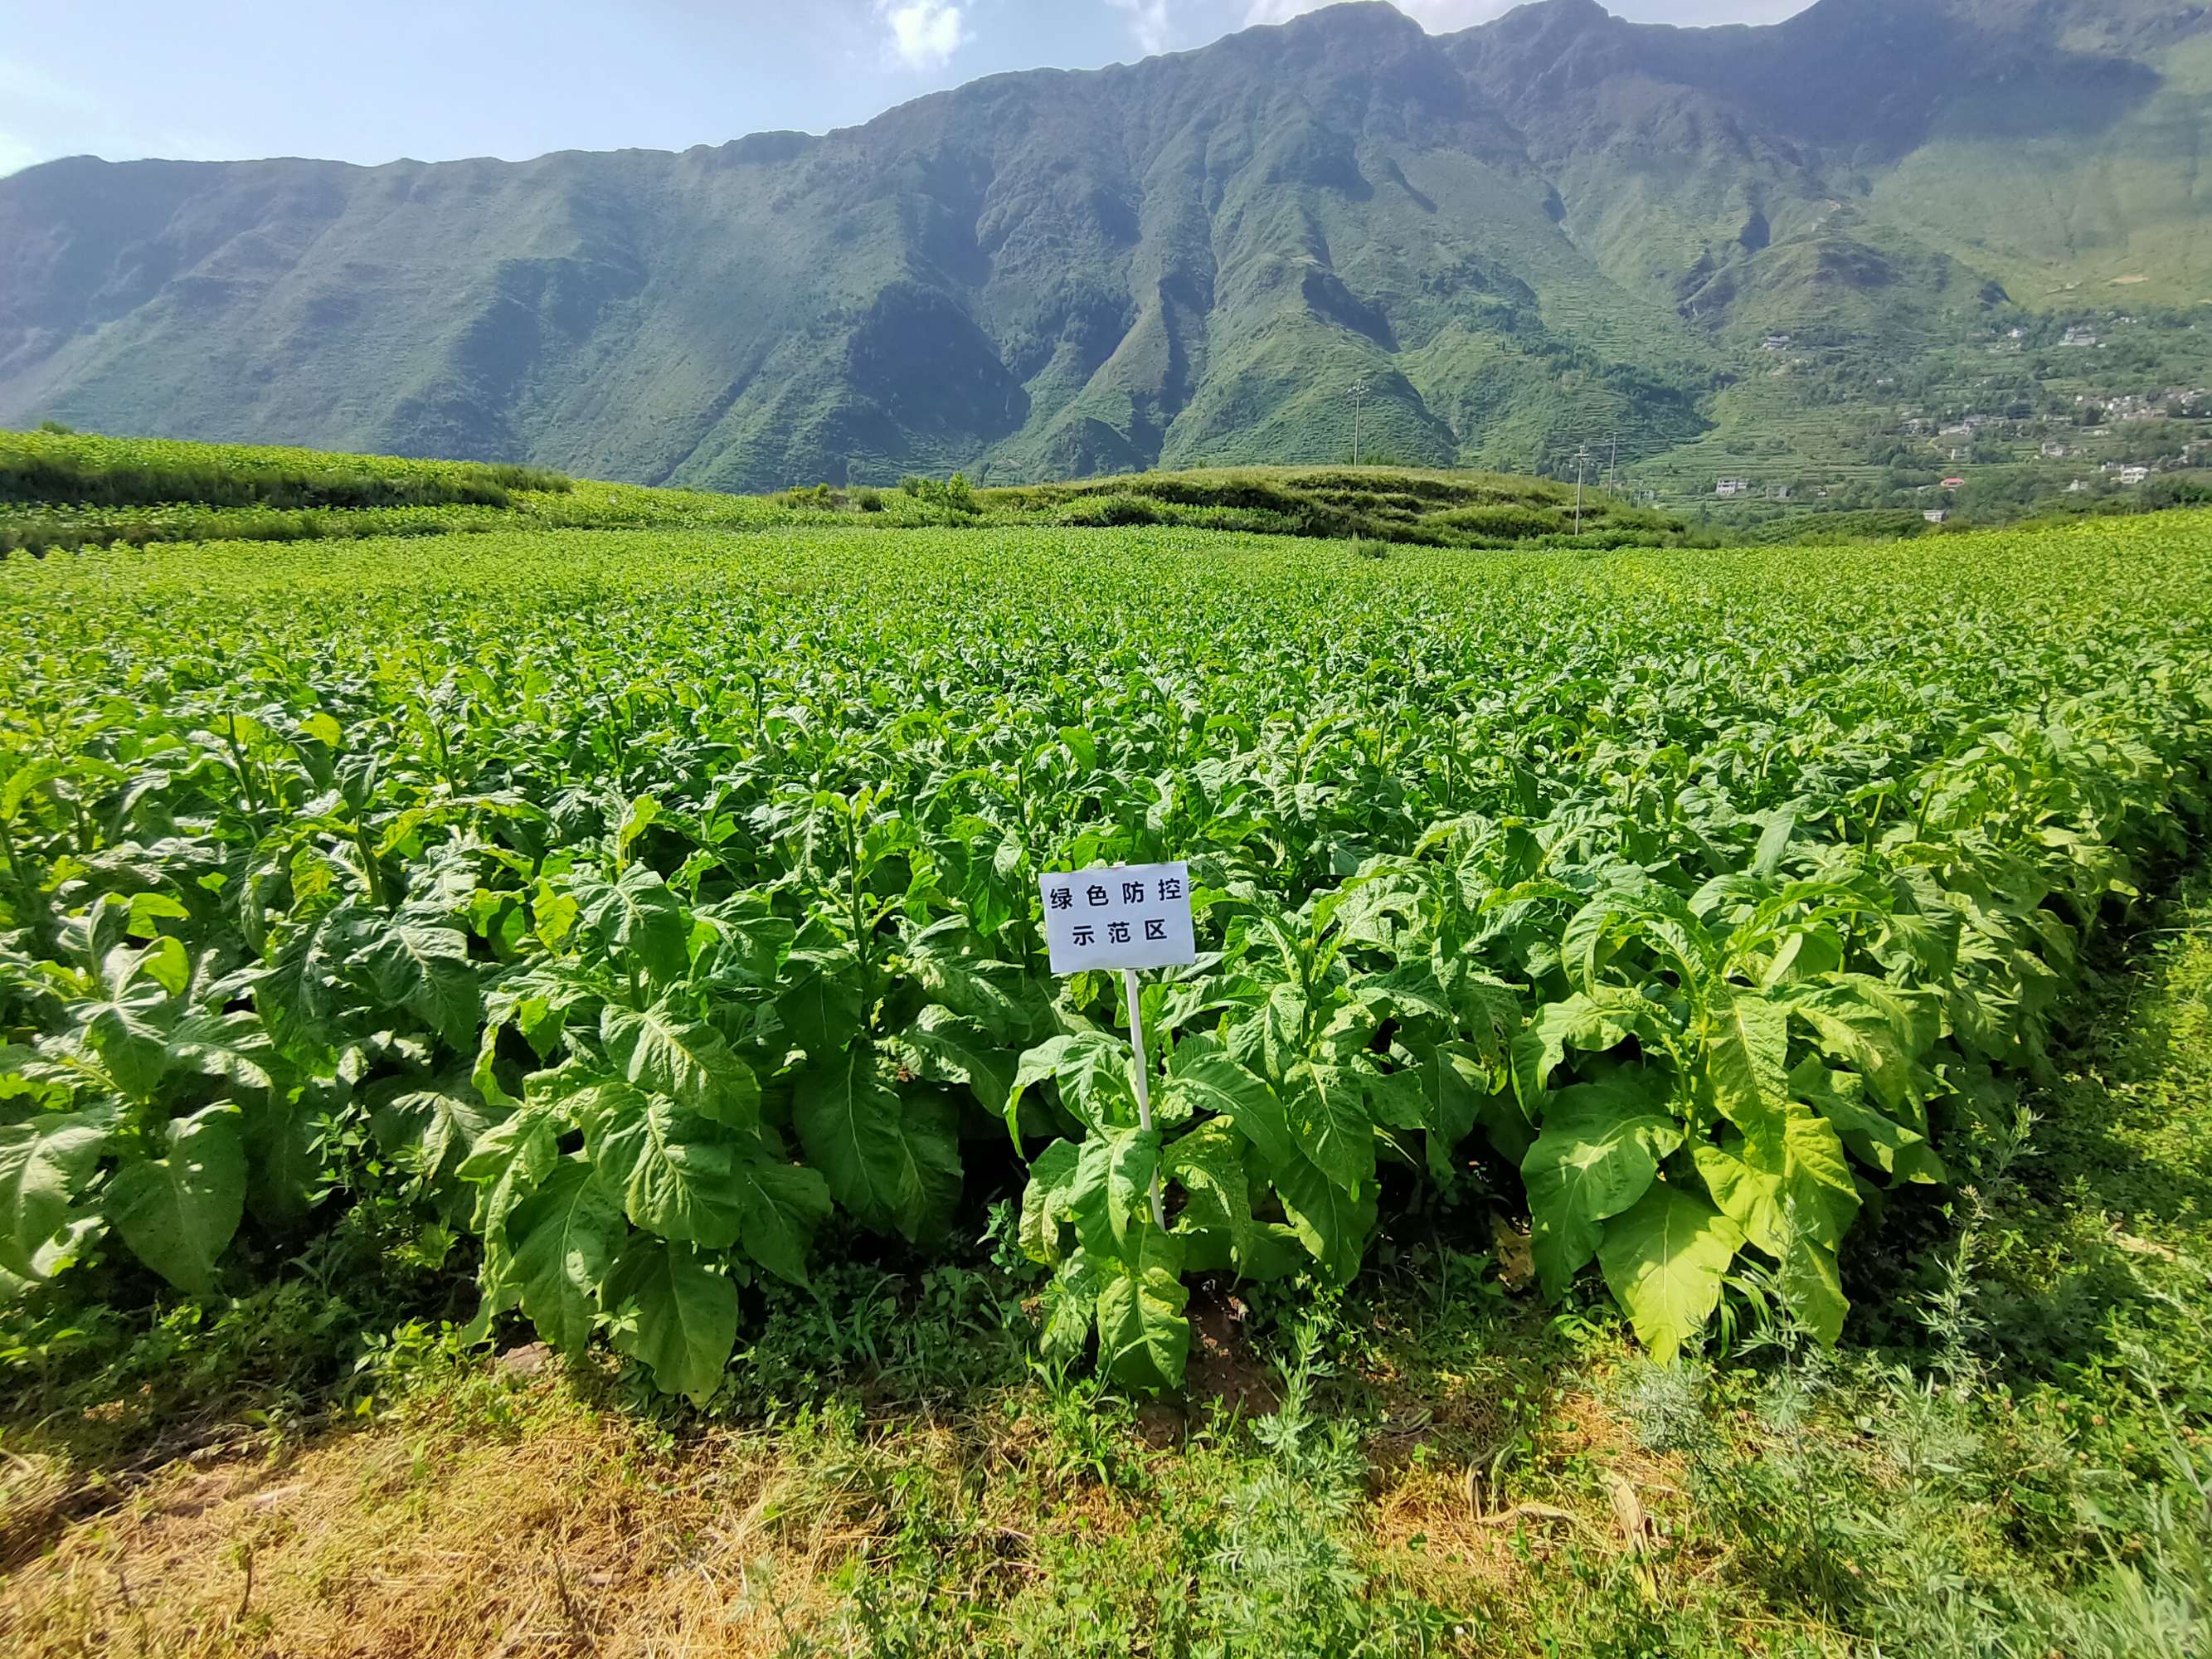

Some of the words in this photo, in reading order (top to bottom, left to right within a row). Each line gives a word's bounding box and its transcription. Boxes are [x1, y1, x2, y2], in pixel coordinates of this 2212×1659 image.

[1049, 878, 1182, 910] 绿色防控
[1072, 918, 1168, 946] 示范区
